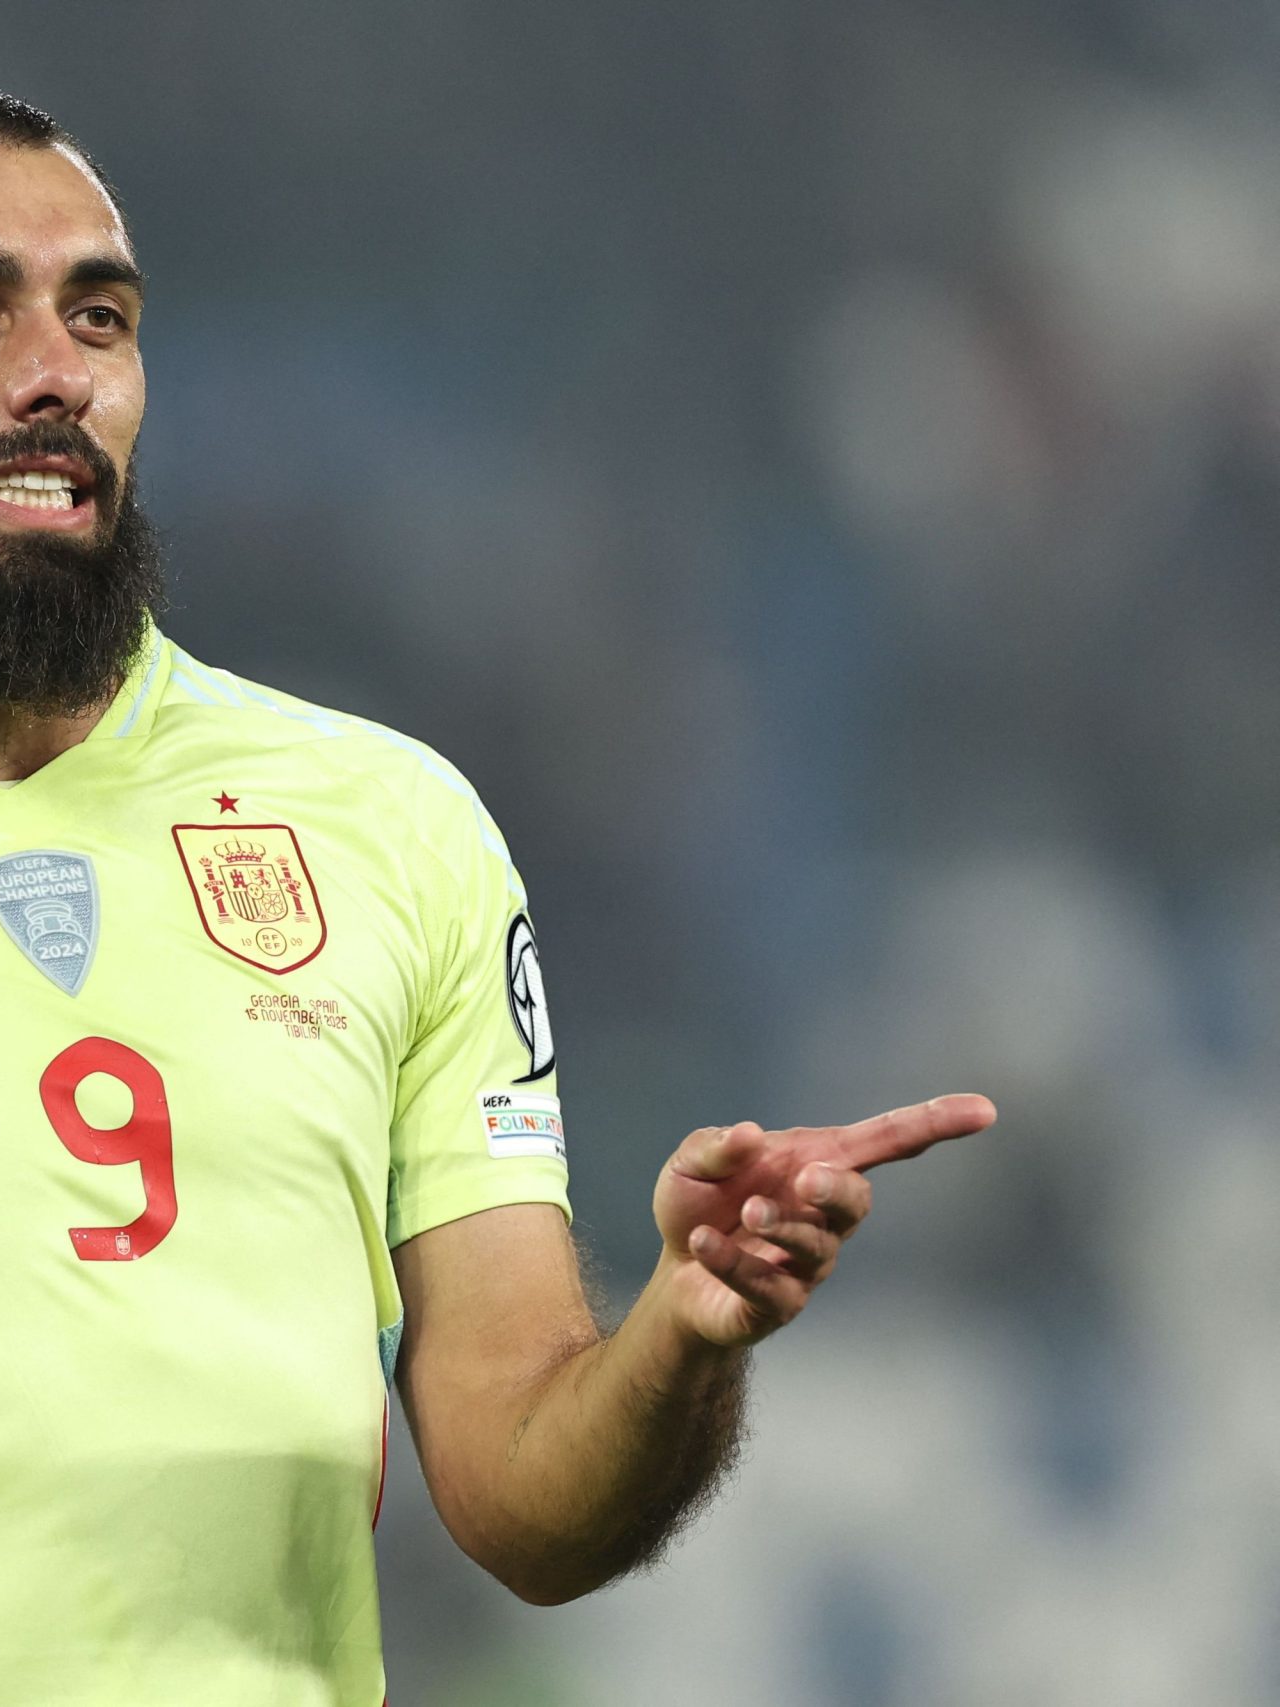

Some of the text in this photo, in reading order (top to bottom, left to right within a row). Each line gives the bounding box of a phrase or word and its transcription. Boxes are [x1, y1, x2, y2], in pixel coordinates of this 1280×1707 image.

[14, 857, 50, 870] UEFA
[37, 942, 83, 960] 2024
[250, 994, 339, 1014] GEORGIA SPAIN
[245, 1008, 348, 1031] 15 NOVEMBER 2025
[483, 1095, 512, 1108] UEFA
[39, 1035, 178, 1262] 9
